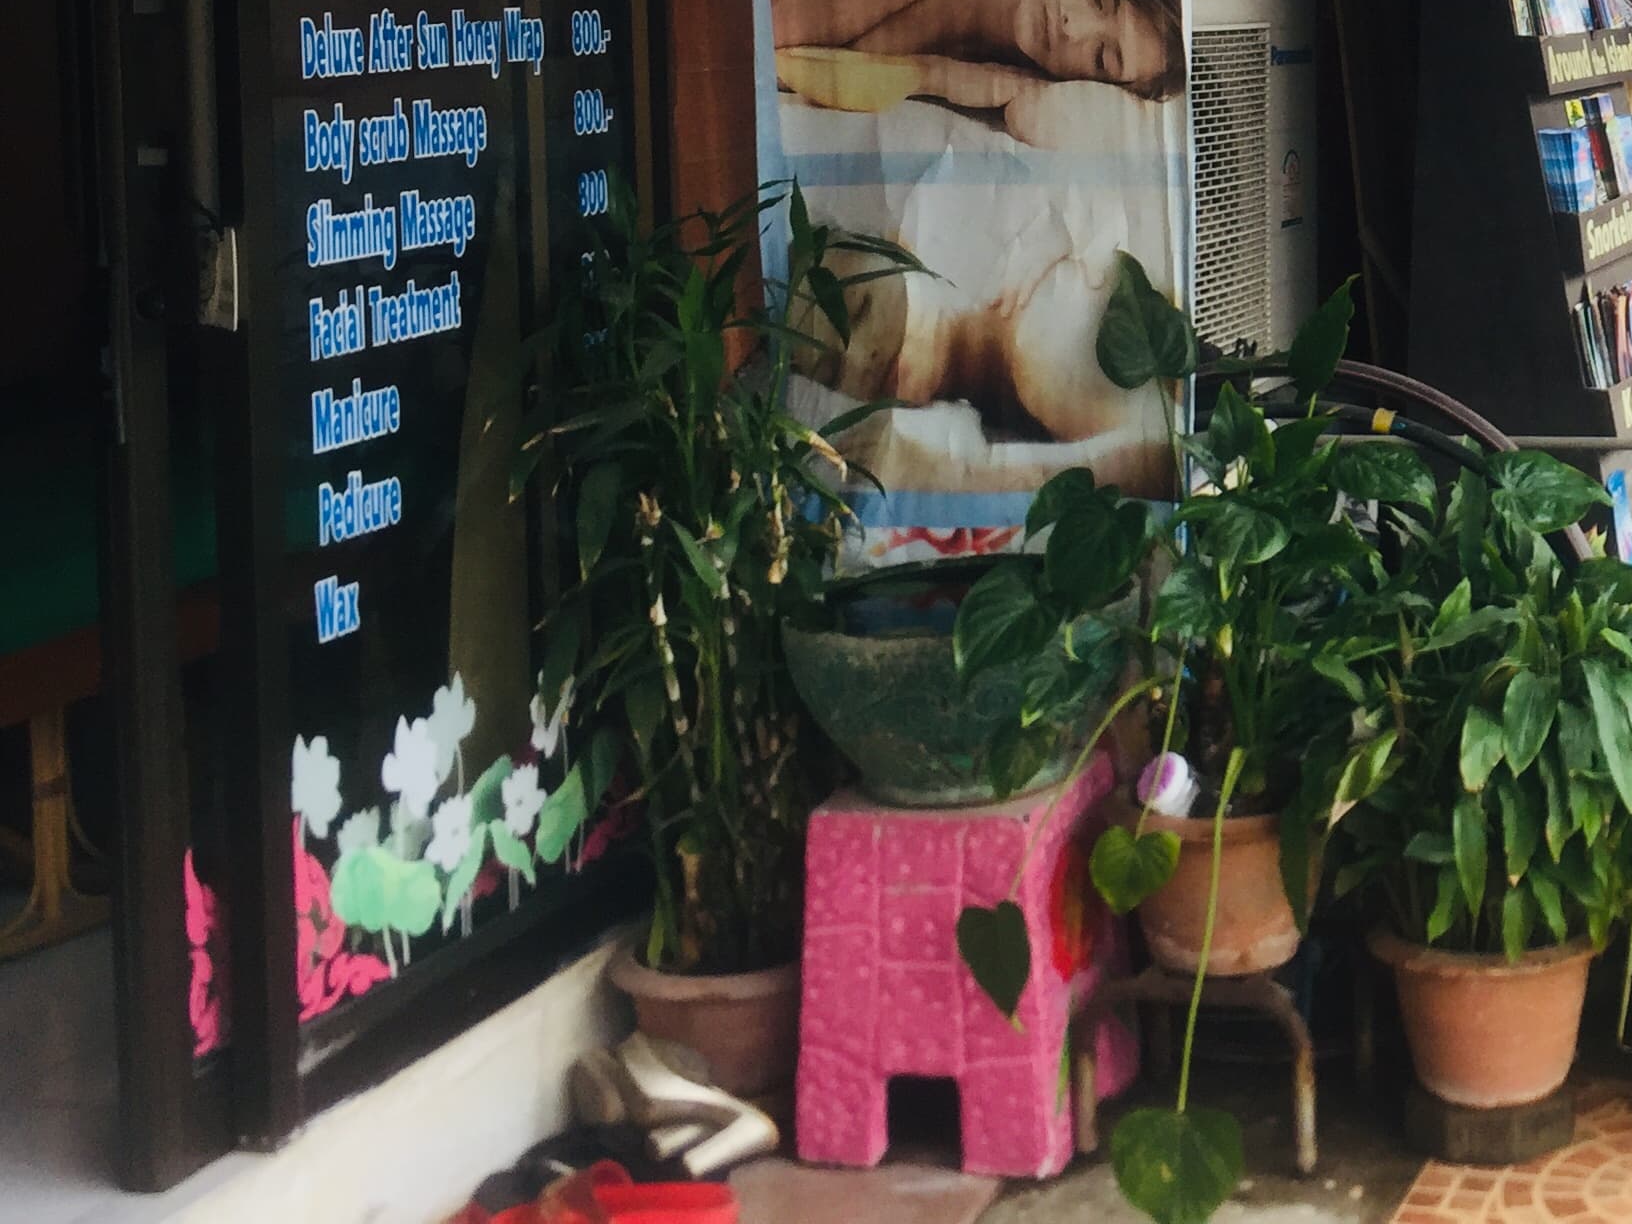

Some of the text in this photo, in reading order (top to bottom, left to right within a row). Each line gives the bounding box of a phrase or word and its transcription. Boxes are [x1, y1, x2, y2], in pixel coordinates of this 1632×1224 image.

[300, 7, 544, 79] Deluxe After Sun Honey Wrap
[1547, 39, 1591, 85] Around
[304, 98, 487, 184] Body scrub Massage
[306, 189, 475, 270] Slimming Massage
[309, 271, 461, 362] Facial Treatment
[311, 377, 400, 455] Manicure
[318, 470, 401, 547] Pedicure
[314, 575, 360, 644] Wax
